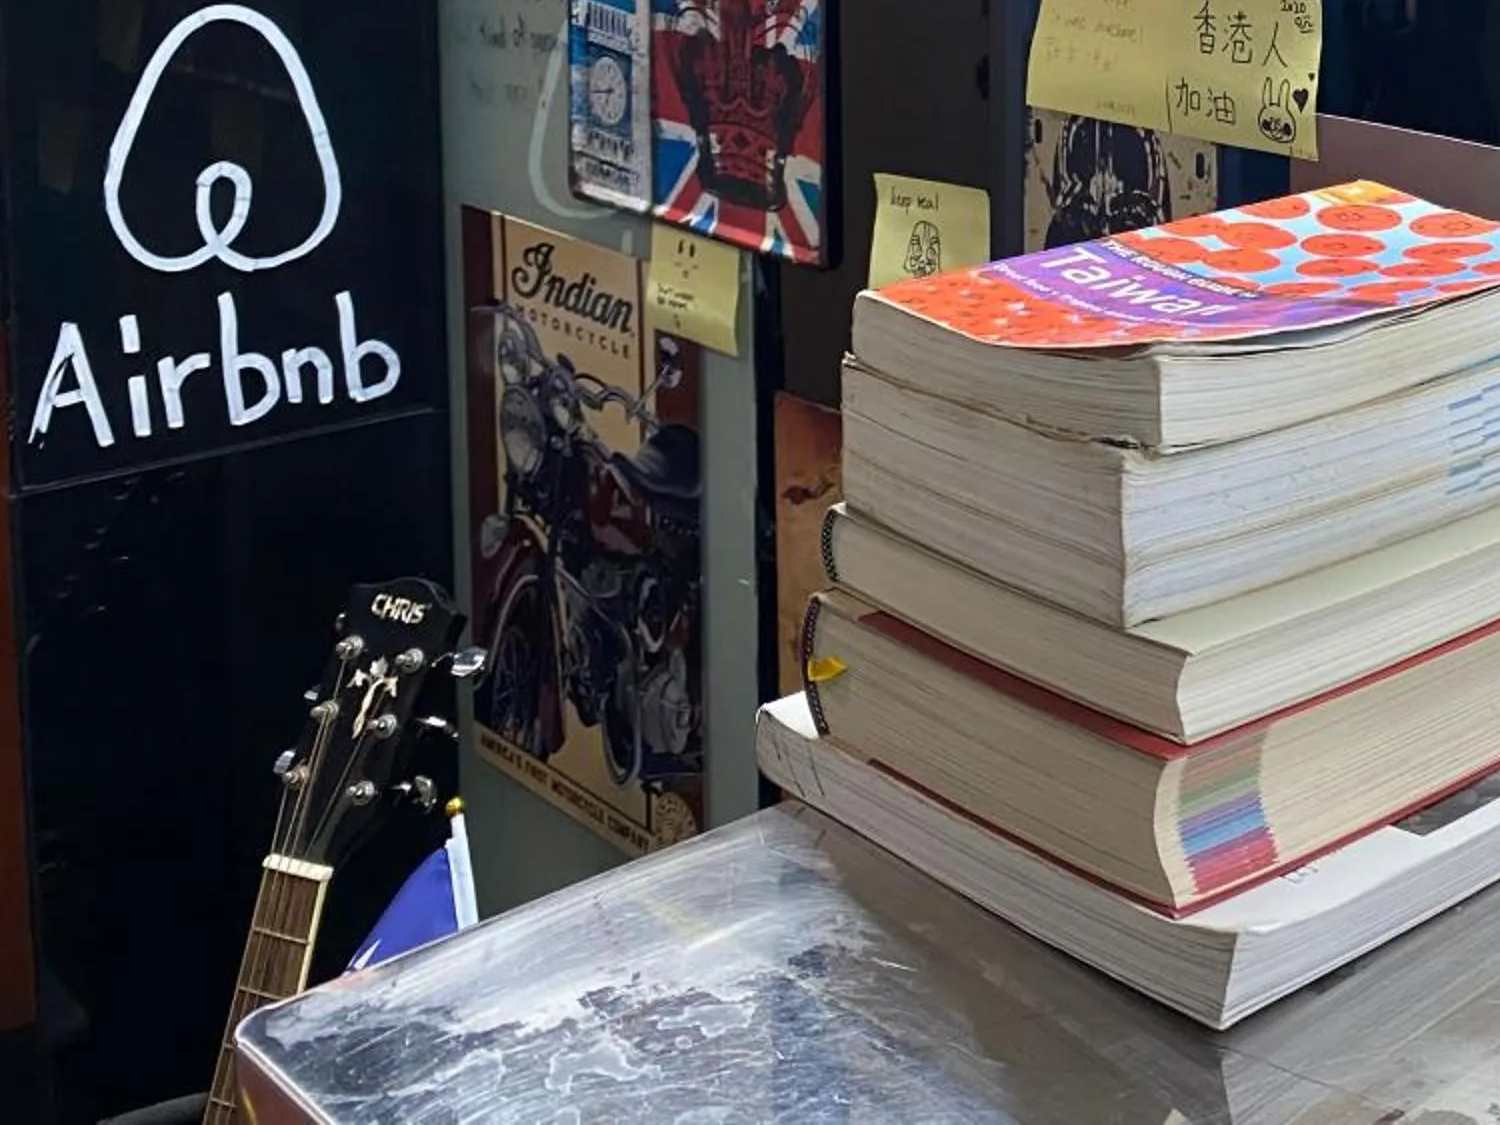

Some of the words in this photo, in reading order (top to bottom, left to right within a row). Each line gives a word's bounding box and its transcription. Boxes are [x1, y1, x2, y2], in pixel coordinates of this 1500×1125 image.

[1193, 0, 1288, 68] 香港人
[1175, 76, 1236, 125] 加油
[511, 242, 634, 335] Indian
[1041, 246, 1239, 316] Taiwan
[515, 302, 632, 360] MOTORCYCLE
[27, 290, 401, 448] Airbnb
[371, 593, 425, 624] CHRIS
